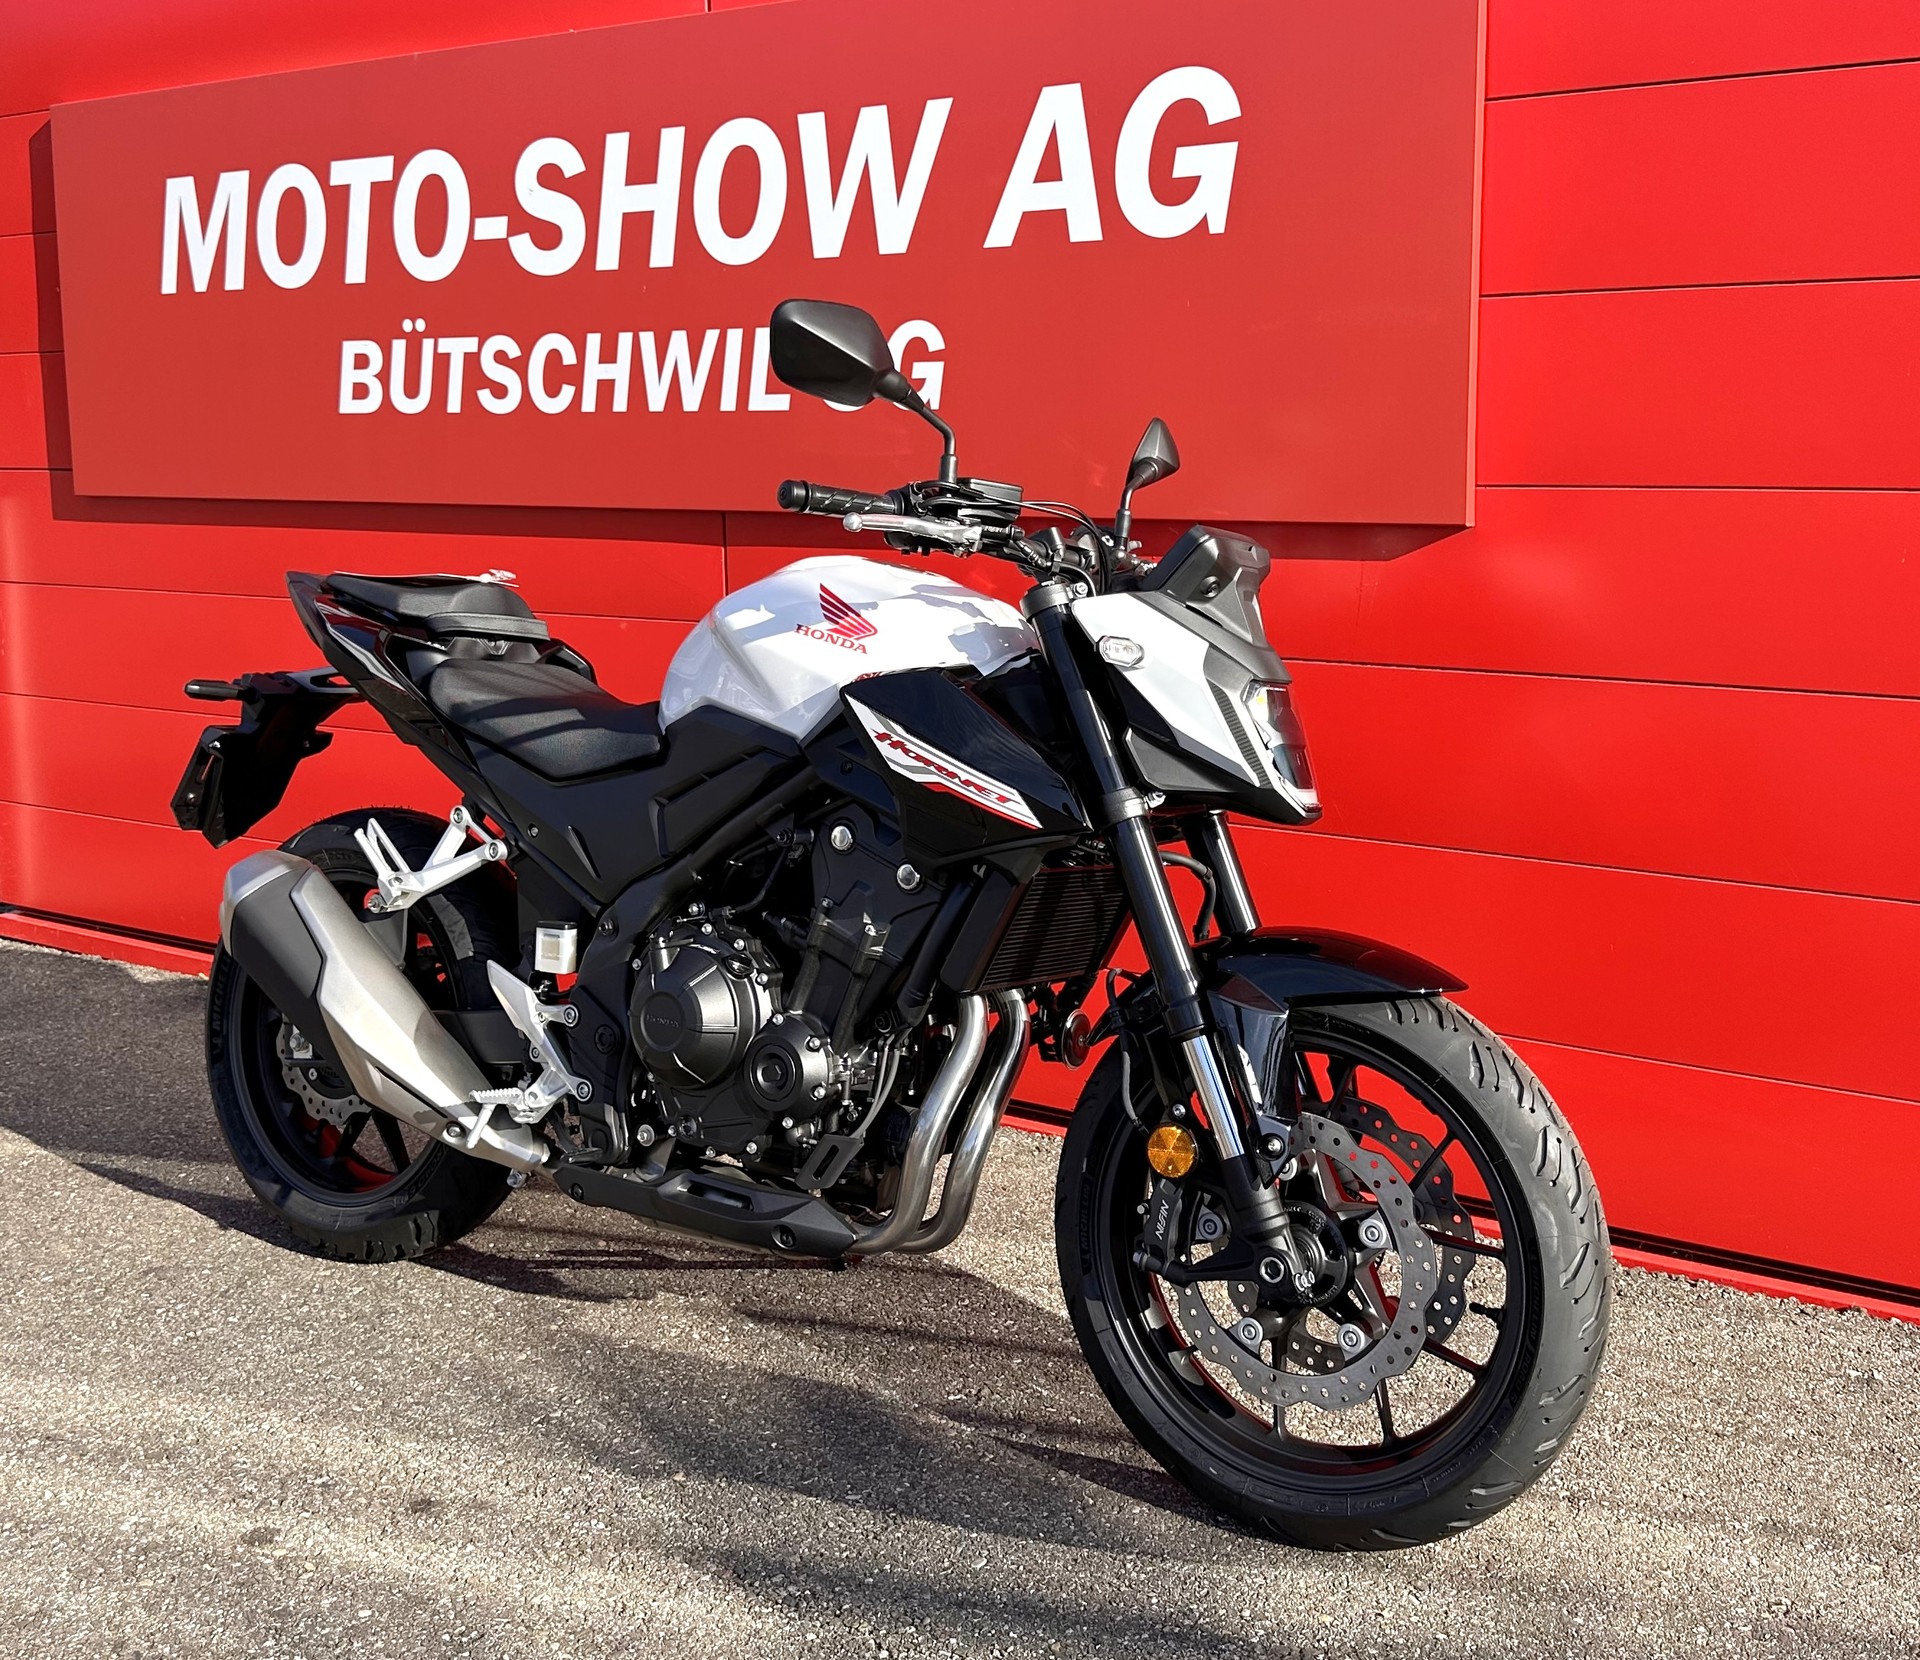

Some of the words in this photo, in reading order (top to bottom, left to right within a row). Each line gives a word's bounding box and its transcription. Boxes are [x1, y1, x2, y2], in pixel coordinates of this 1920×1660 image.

[161, 97, 954, 295] MOTO-SHOW
[982, 66, 1242, 249] AG
[339, 318, 791, 414] BÜTSCHWIL
[823, 319, 946, 413] G
[795, 624, 867, 654] HONDA
[870, 728, 1023, 805] HORNET
[1080, 1184, 1090, 1251] MICHELIN
[1530, 1265, 1541, 1342] MICHELIN
